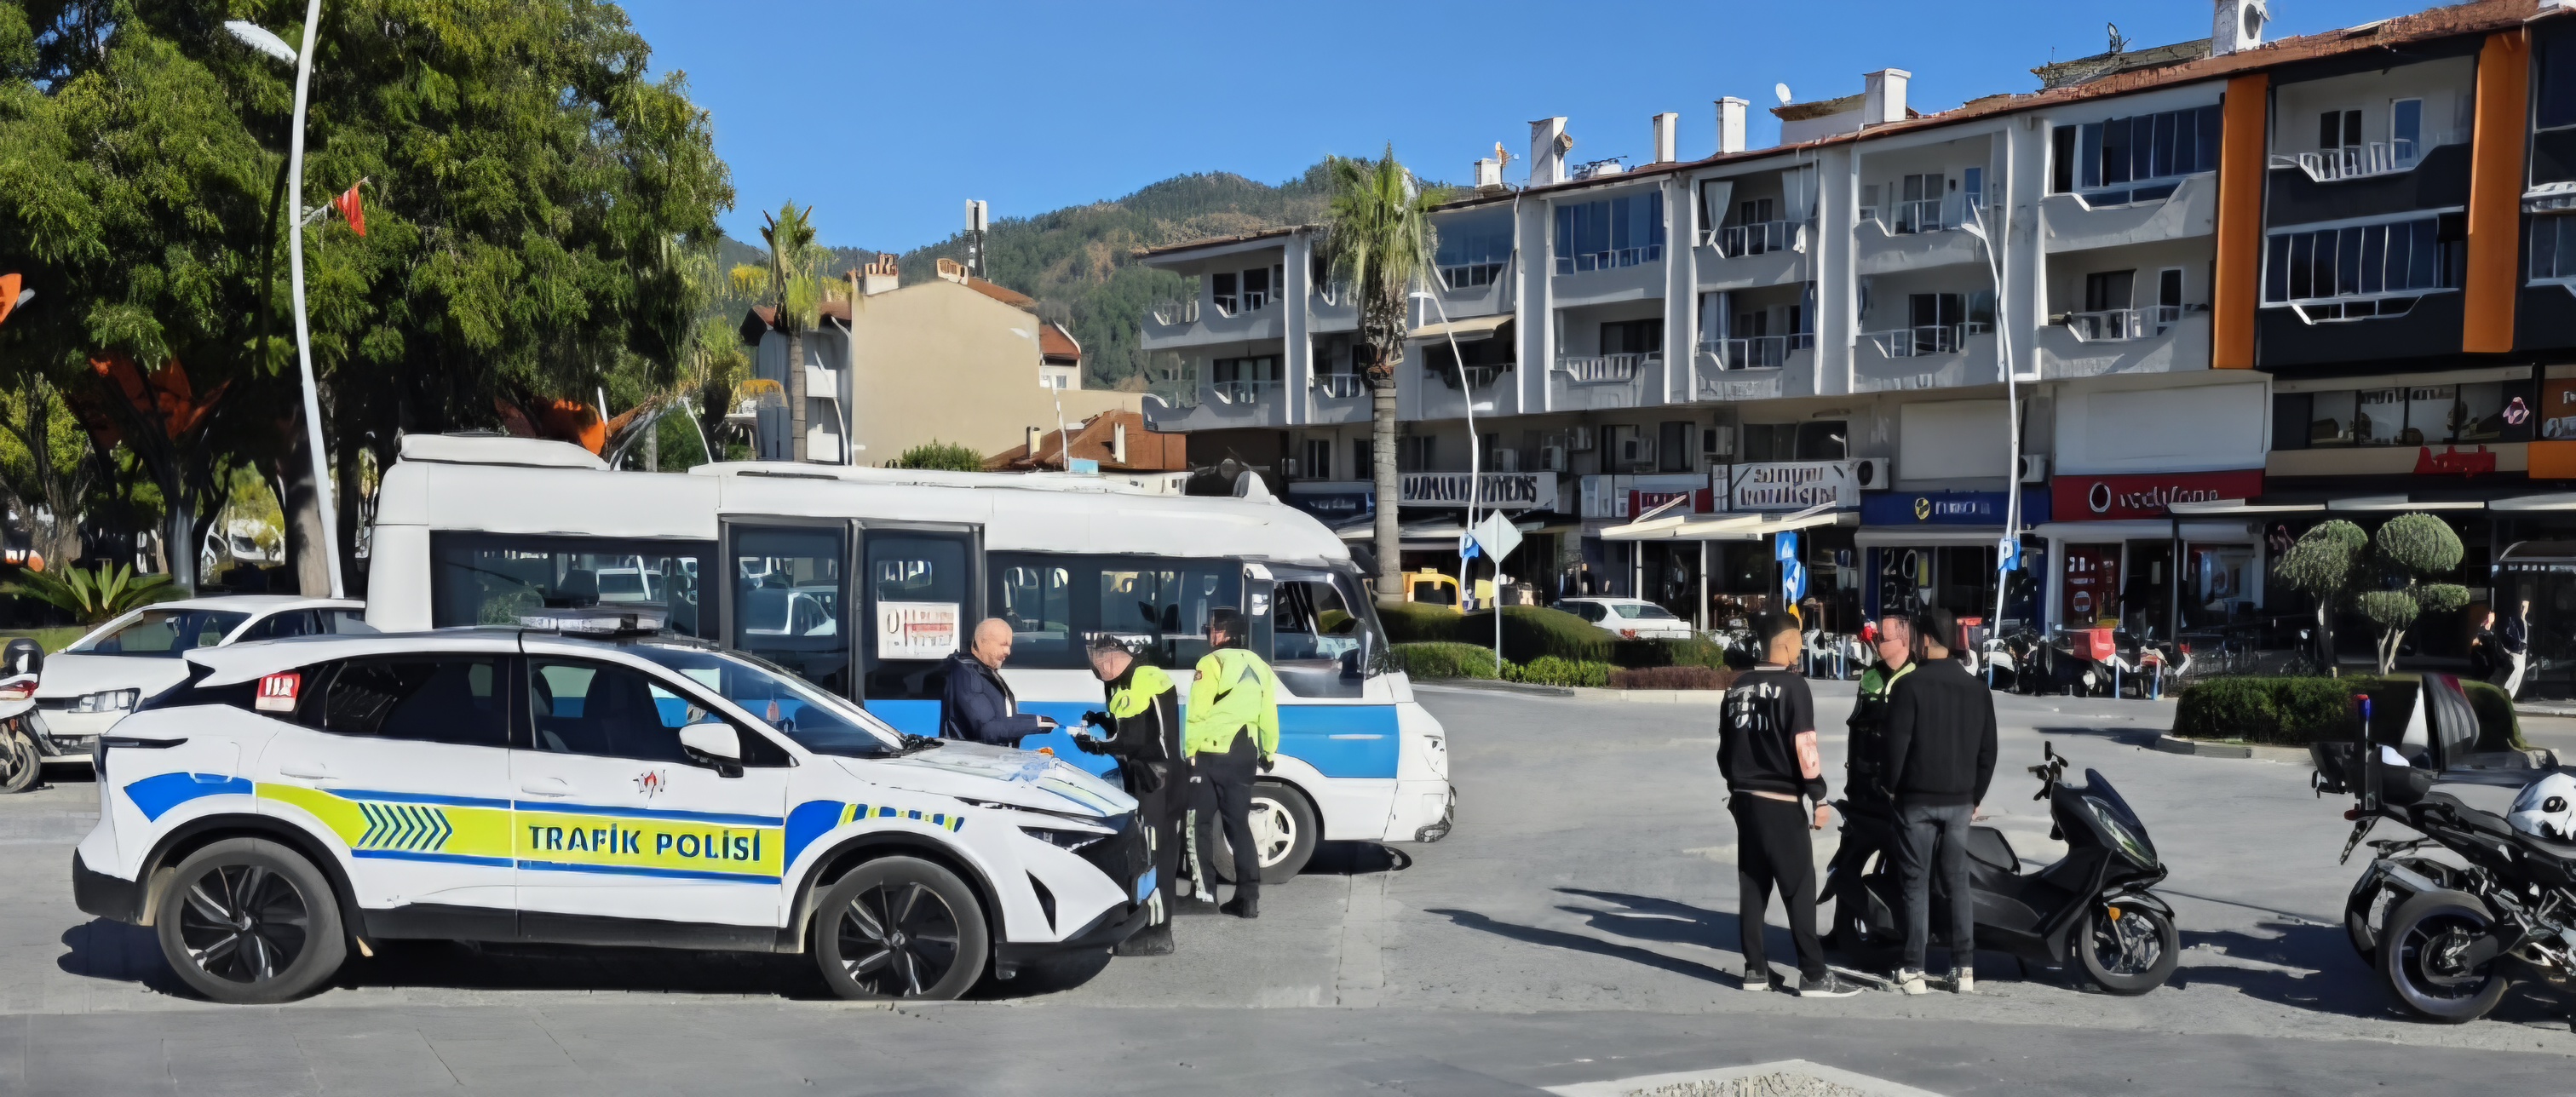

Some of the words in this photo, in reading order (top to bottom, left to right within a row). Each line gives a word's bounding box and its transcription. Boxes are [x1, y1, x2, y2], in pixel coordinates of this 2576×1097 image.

[265, 676, 294, 697] 112
[528, 823, 641, 854] TRAFİK
[656, 829, 761, 862] POLİSİ
